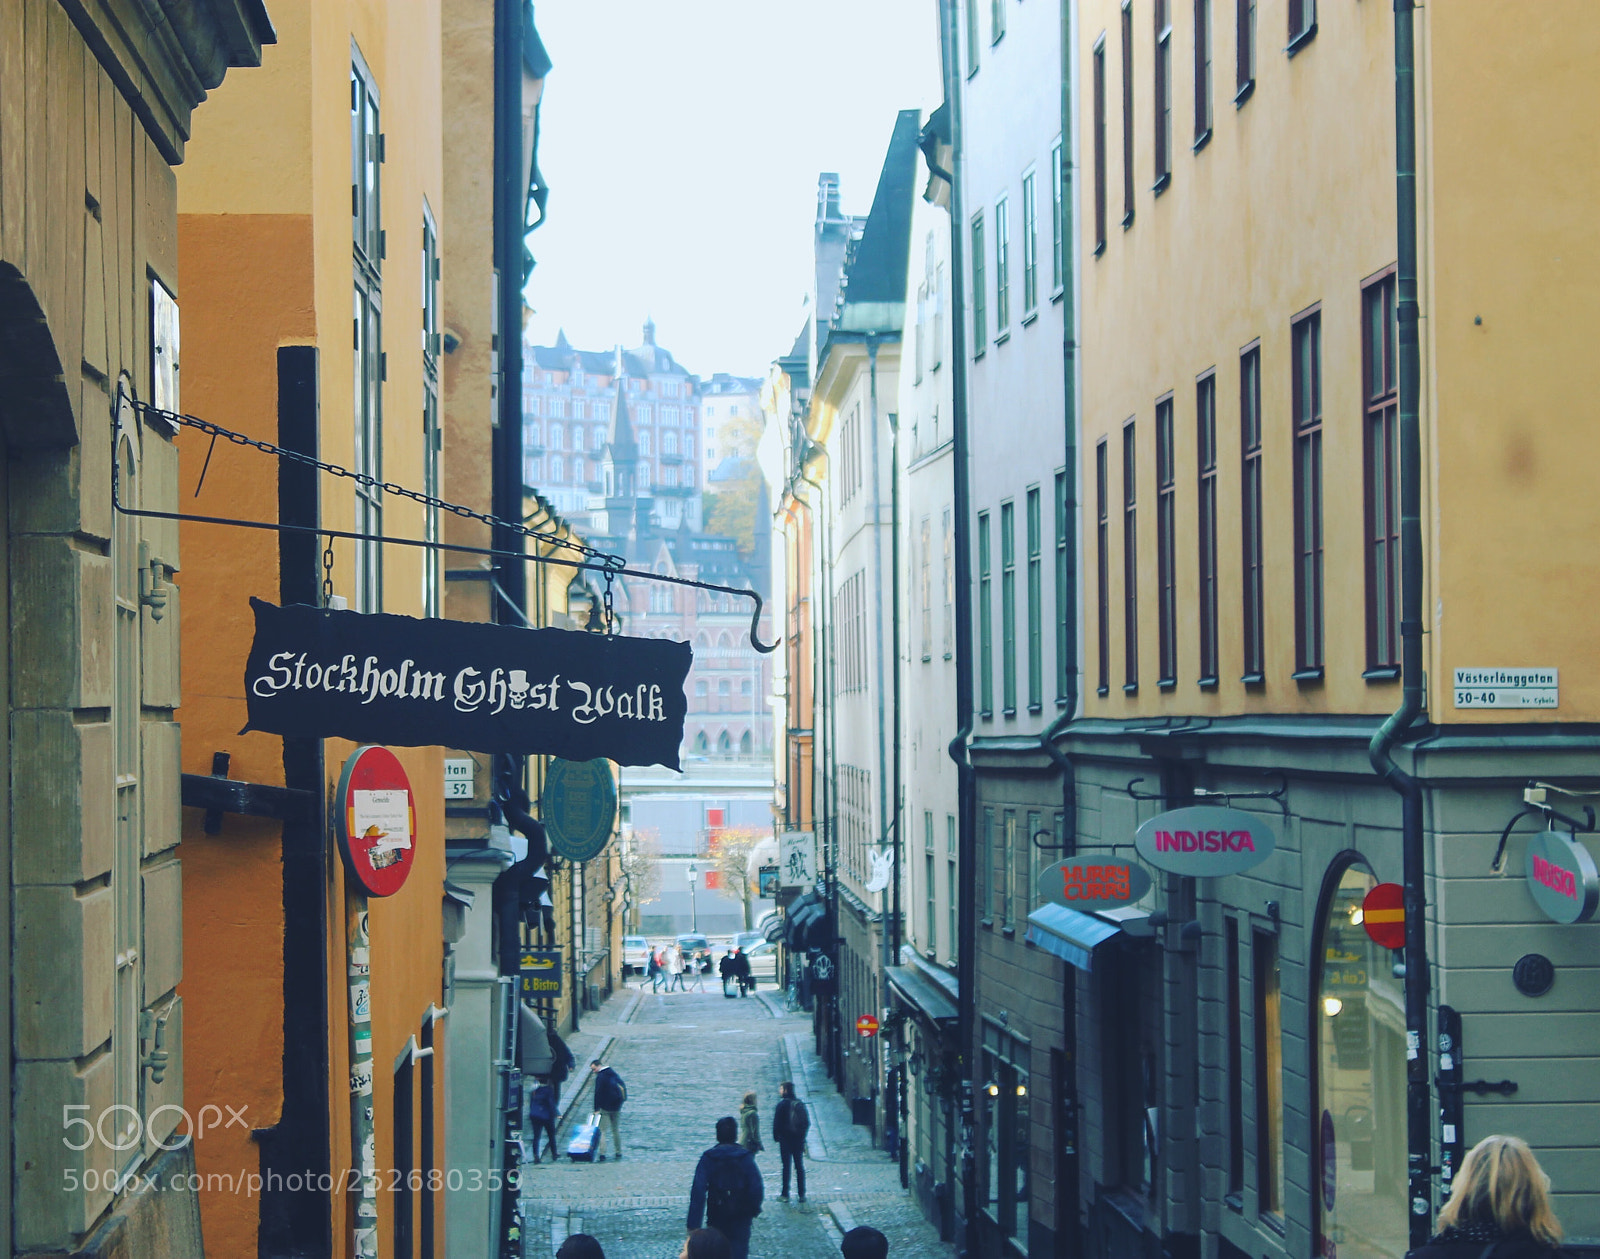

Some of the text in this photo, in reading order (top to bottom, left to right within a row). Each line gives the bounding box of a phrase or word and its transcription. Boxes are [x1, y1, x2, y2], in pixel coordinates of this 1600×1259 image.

[1457, 671, 1553, 687] Västerlånggatan
[252, 651, 446, 704] Stockholm
[567, 680, 667, 724] Walk
[1458, 692, 1496, 704] 50-40
[445, 764, 467, 775] tan
[453, 783, 467, 795] 52
[1155, 830, 1256, 853] INDISKA
[1061, 865, 1129, 883] HURRY
[1532, 854, 1578, 901] INDISKA
[1064, 883, 1131, 900] CURRY
[523, 977, 559, 991] & Bistro
